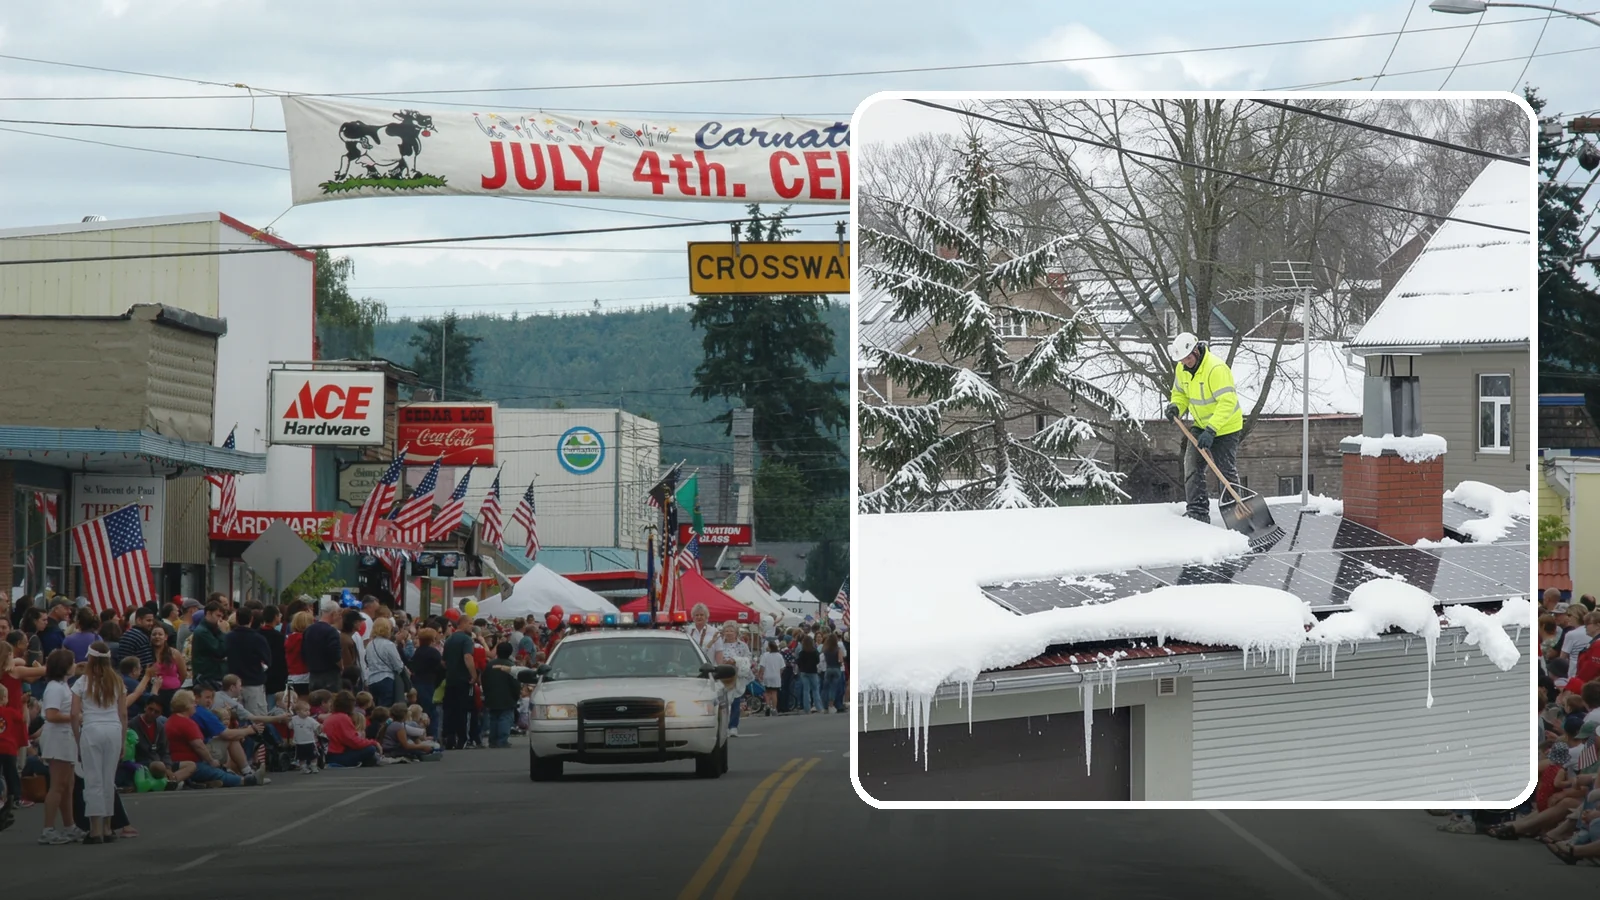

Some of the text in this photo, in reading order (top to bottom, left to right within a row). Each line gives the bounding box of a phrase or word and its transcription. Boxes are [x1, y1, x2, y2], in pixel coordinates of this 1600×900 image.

[482, 141, 604, 191] JULY
[632, 150, 746, 197] 4th.
[697, 254, 850, 280] CROSSWA
[283, 380, 373, 420] ACE
[405, 409, 452, 422] CEDAR
[284, 421, 370, 436] Hardware
[416, 428, 477, 447] Coca-Cola
[353, 467, 384, 479] Simpl
[83, 485, 155, 495] St. Vincent de Paul
[688, 526, 741, 535] CRNATION
[699, 535, 731, 543] GLASS
